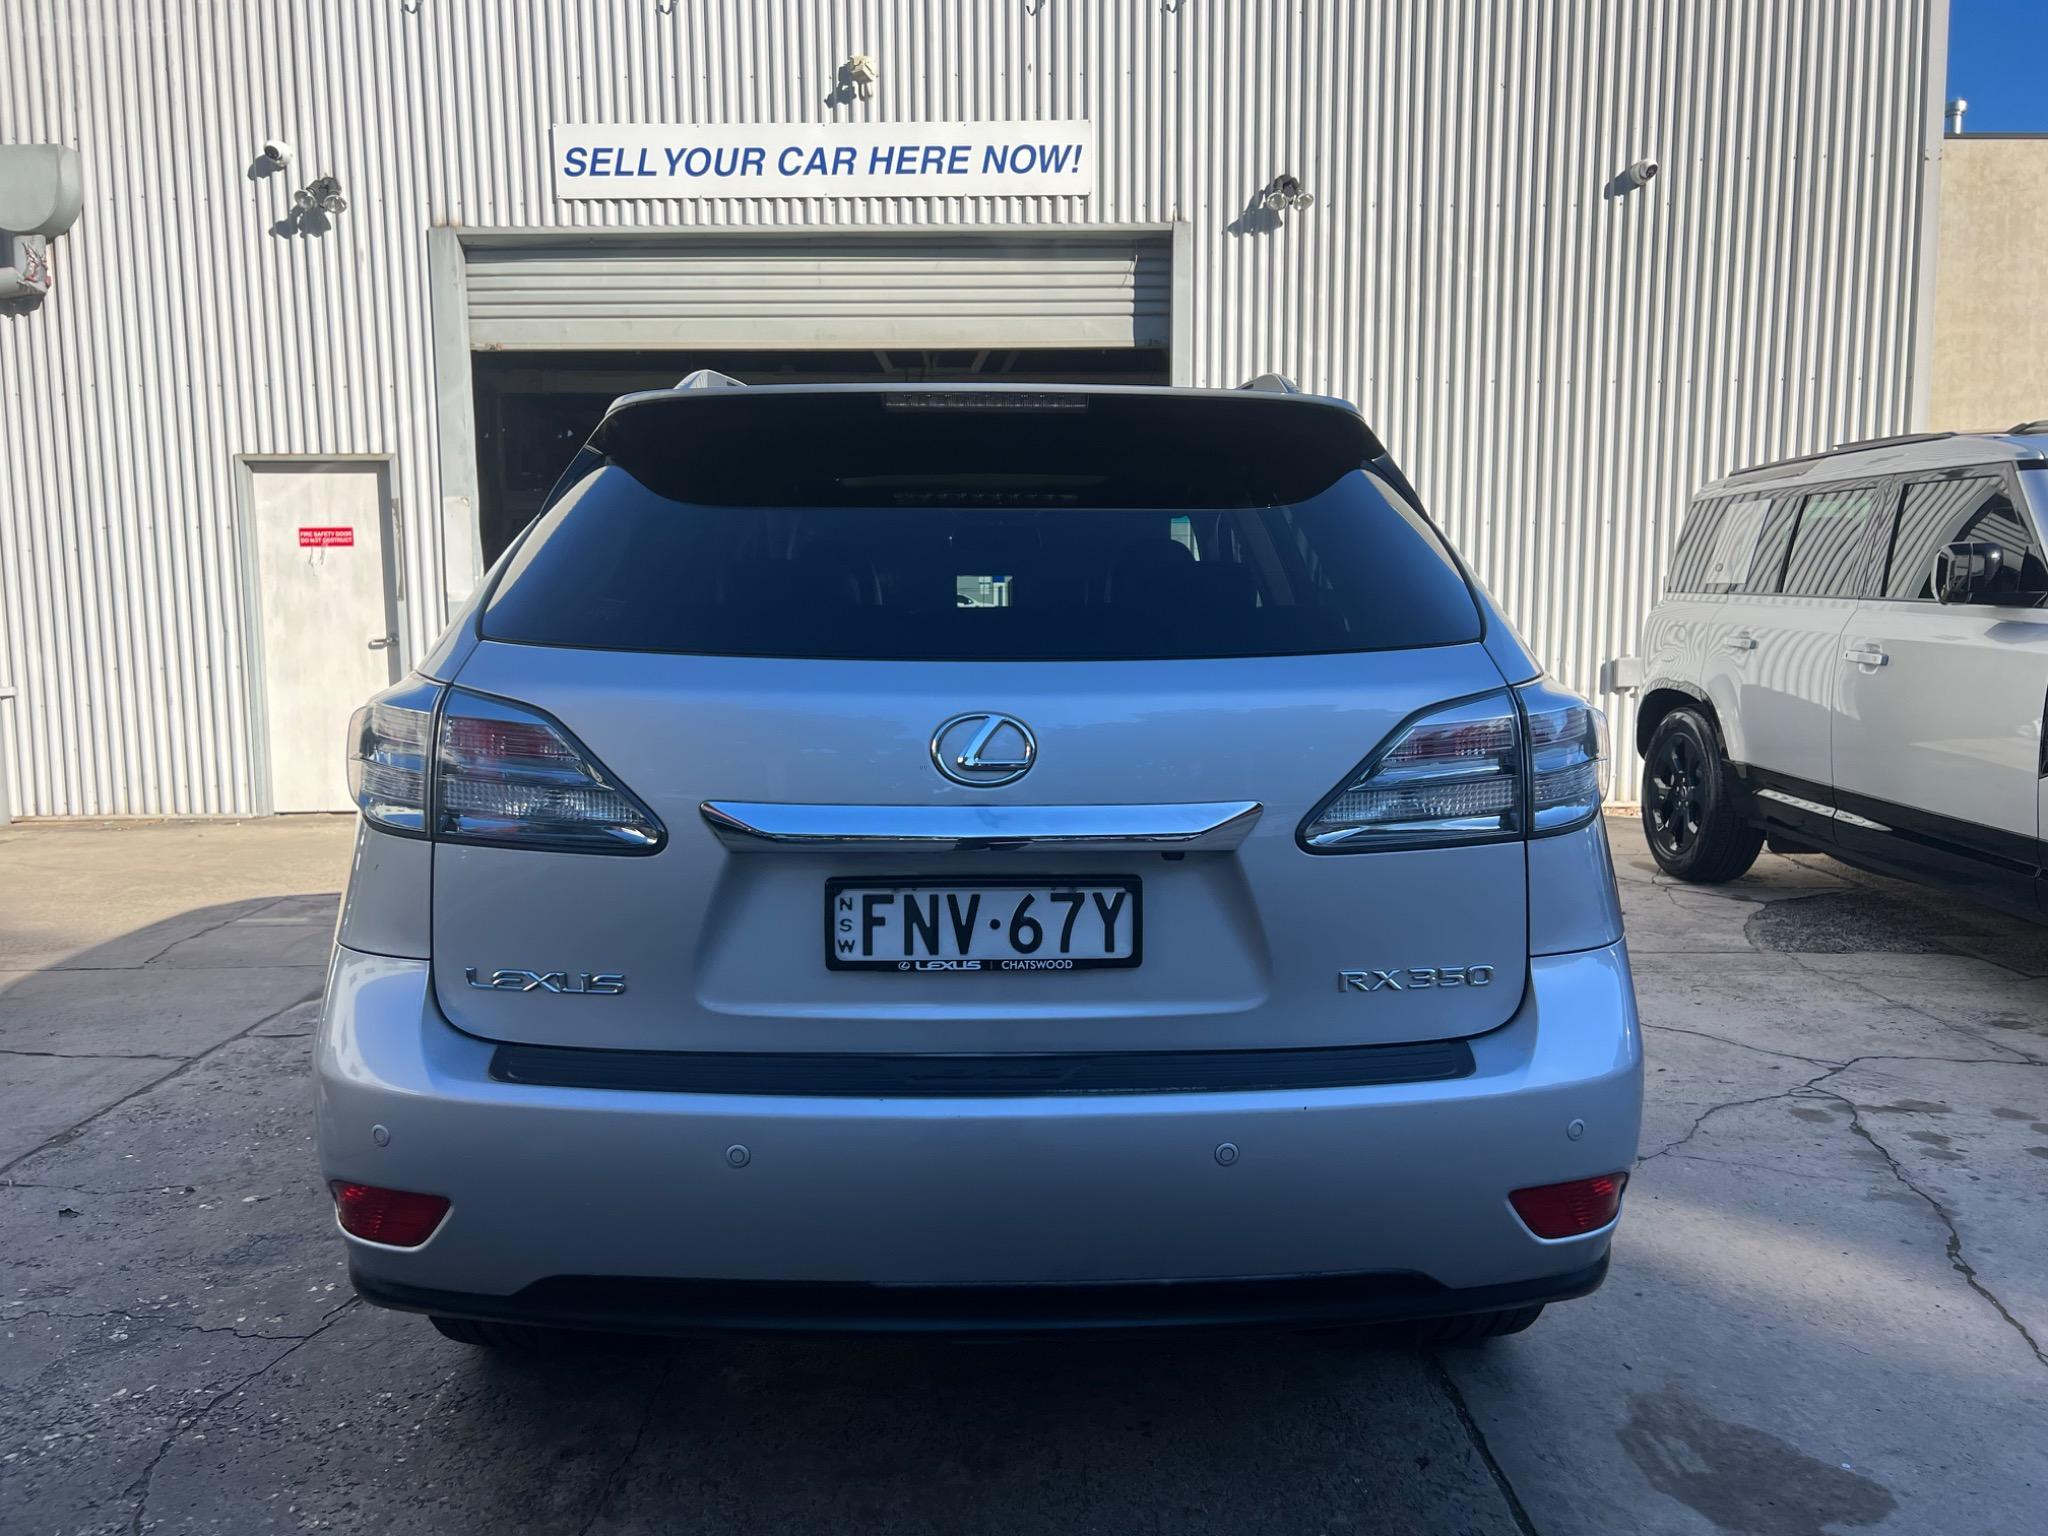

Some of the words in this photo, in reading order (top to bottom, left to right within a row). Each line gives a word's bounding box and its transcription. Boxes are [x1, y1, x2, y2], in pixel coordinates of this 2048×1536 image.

[563, 147, 658, 177] SELL
[664, 147, 766, 177] YOUR
[777, 146, 857, 177] CAR
[868, 145, 972, 175] HERE
[981, 144, 1083, 174] NOW!
[915, 960, 981, 971] LEXUS
[1001, 959, 1073, 970] CHATSWOOD
[465, 967, 625, 995] LEXUS
